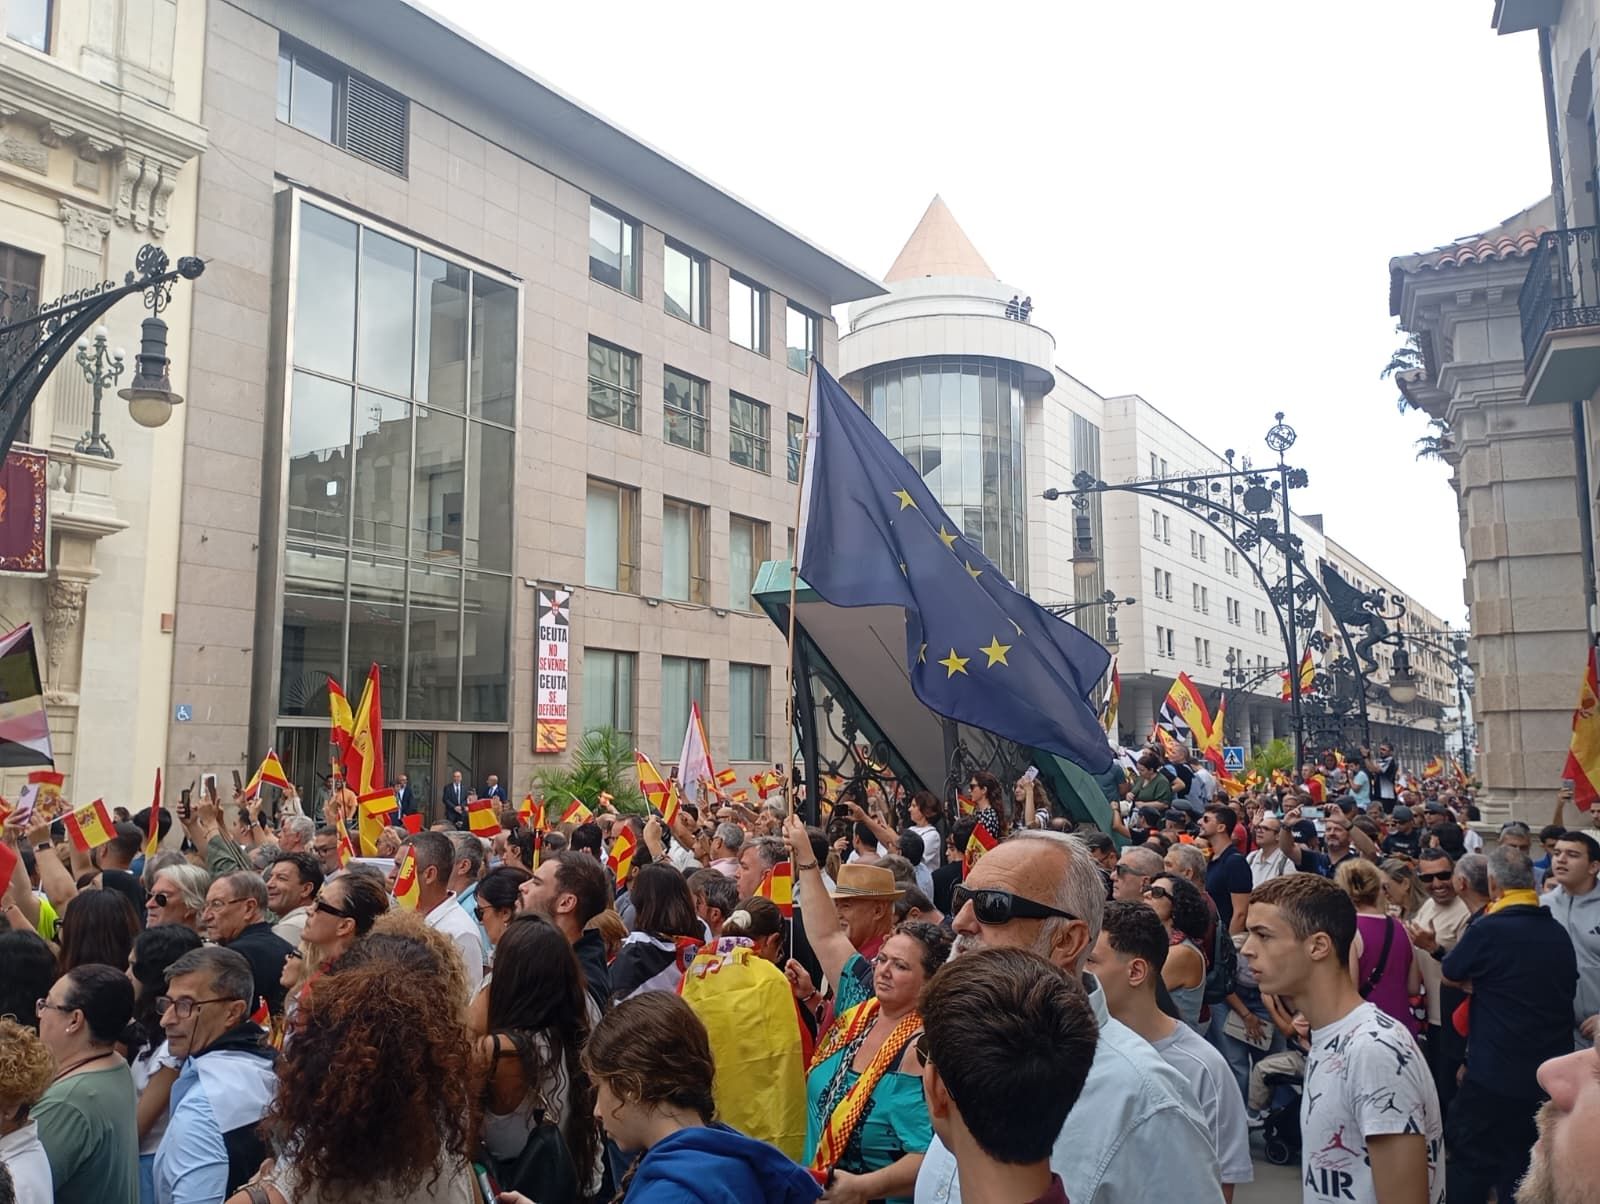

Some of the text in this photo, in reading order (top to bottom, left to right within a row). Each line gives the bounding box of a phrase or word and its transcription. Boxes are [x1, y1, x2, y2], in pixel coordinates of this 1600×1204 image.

[540, 626, 567, 642] CEUTA
[548, 644, 558, 656] NO
[540, 658, 547, 670] SE
[540, 674, 566, 690] CEUTA
[548, 691, 557, 703] SE
[538, 703, 567, 717] DEFIENDE
[1305, 1163, 1356, 1200] AIR
